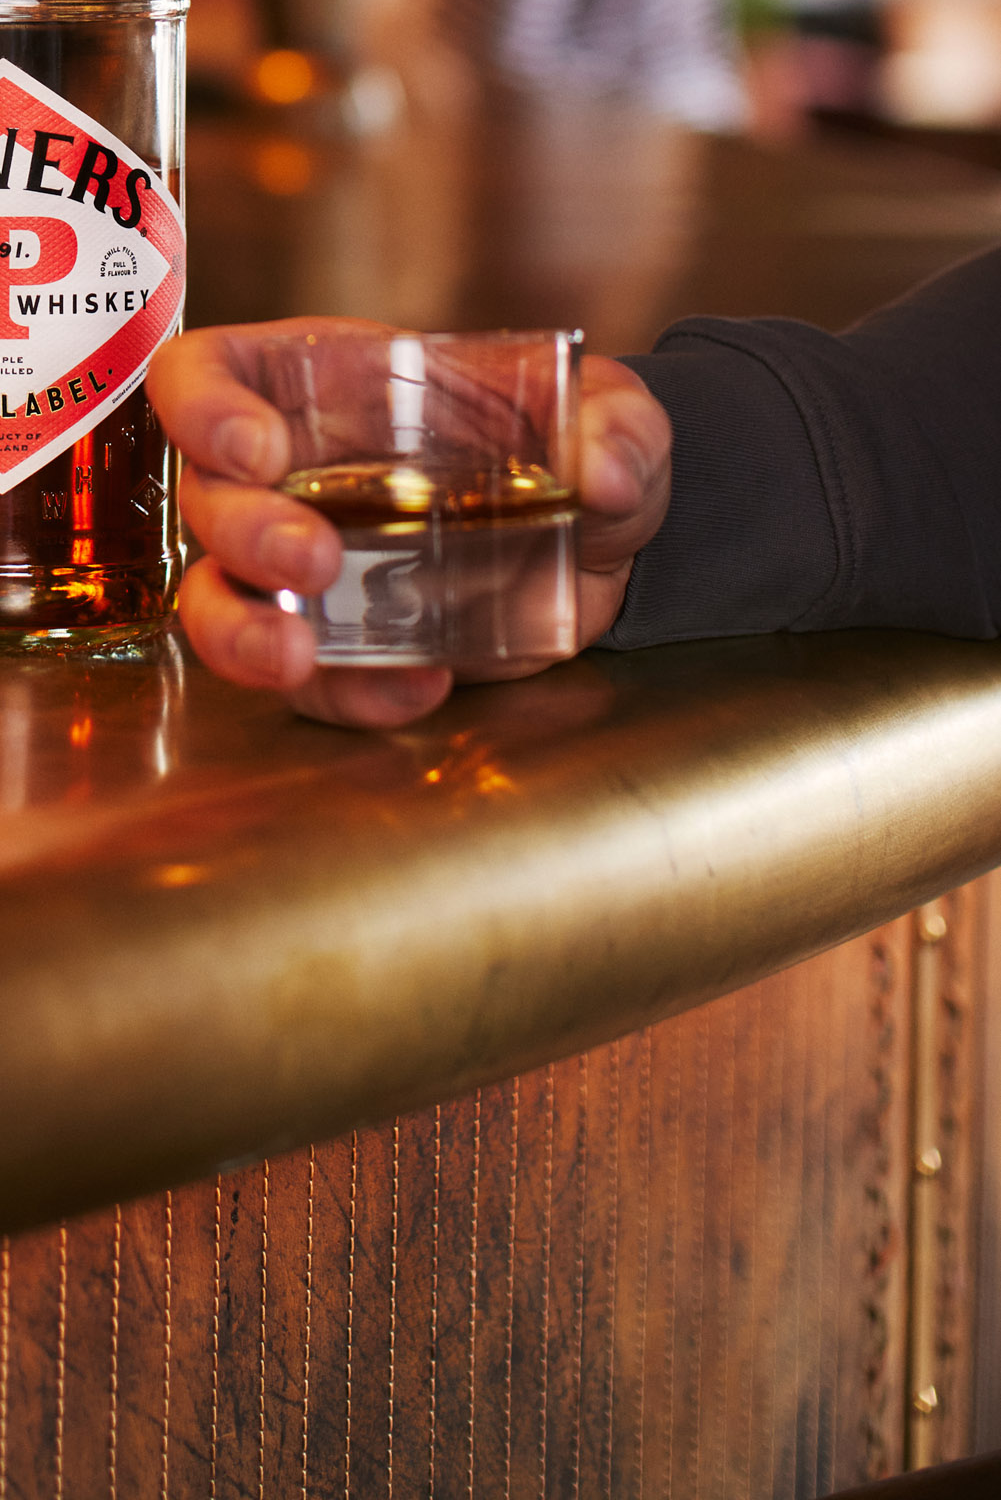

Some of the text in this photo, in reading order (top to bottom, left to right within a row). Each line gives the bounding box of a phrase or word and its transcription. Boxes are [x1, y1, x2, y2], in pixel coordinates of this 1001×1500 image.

[104, 246, 121, 260] CHILL
[122, 246, 138, 275] FILTERED
[107, 269, 131, 277] FLAVOUR
[17, 288, 150, 315] WHISKEY
[1, 370, 107, 419] LABEL
[25, 432, 42, 440] OF
